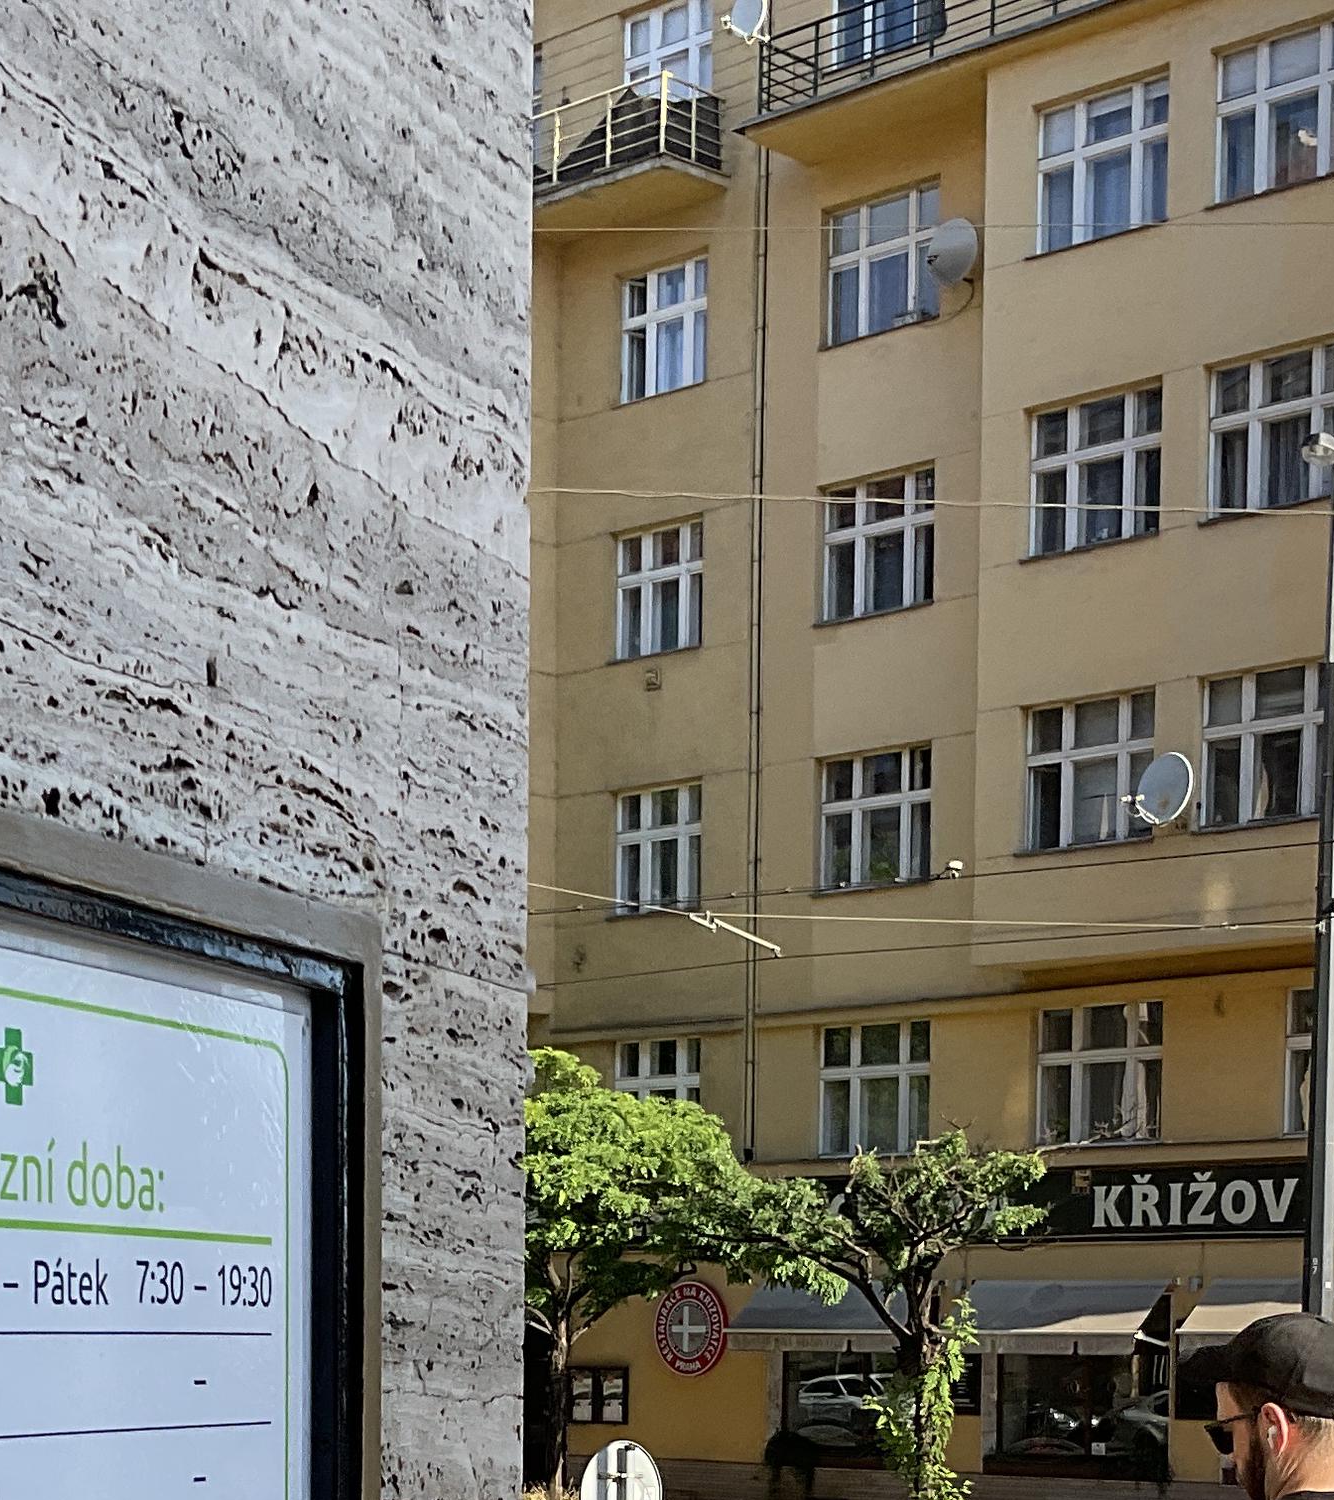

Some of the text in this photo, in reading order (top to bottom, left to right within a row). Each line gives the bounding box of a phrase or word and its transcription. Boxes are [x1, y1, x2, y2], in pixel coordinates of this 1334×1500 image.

[67, 1141, 166, 1213] doba:
[33, 1257, 110, 1307] Pátek
[135, 1259, 185, 1306] 7:30
[217, 1263, 273, 1308] 19:30
